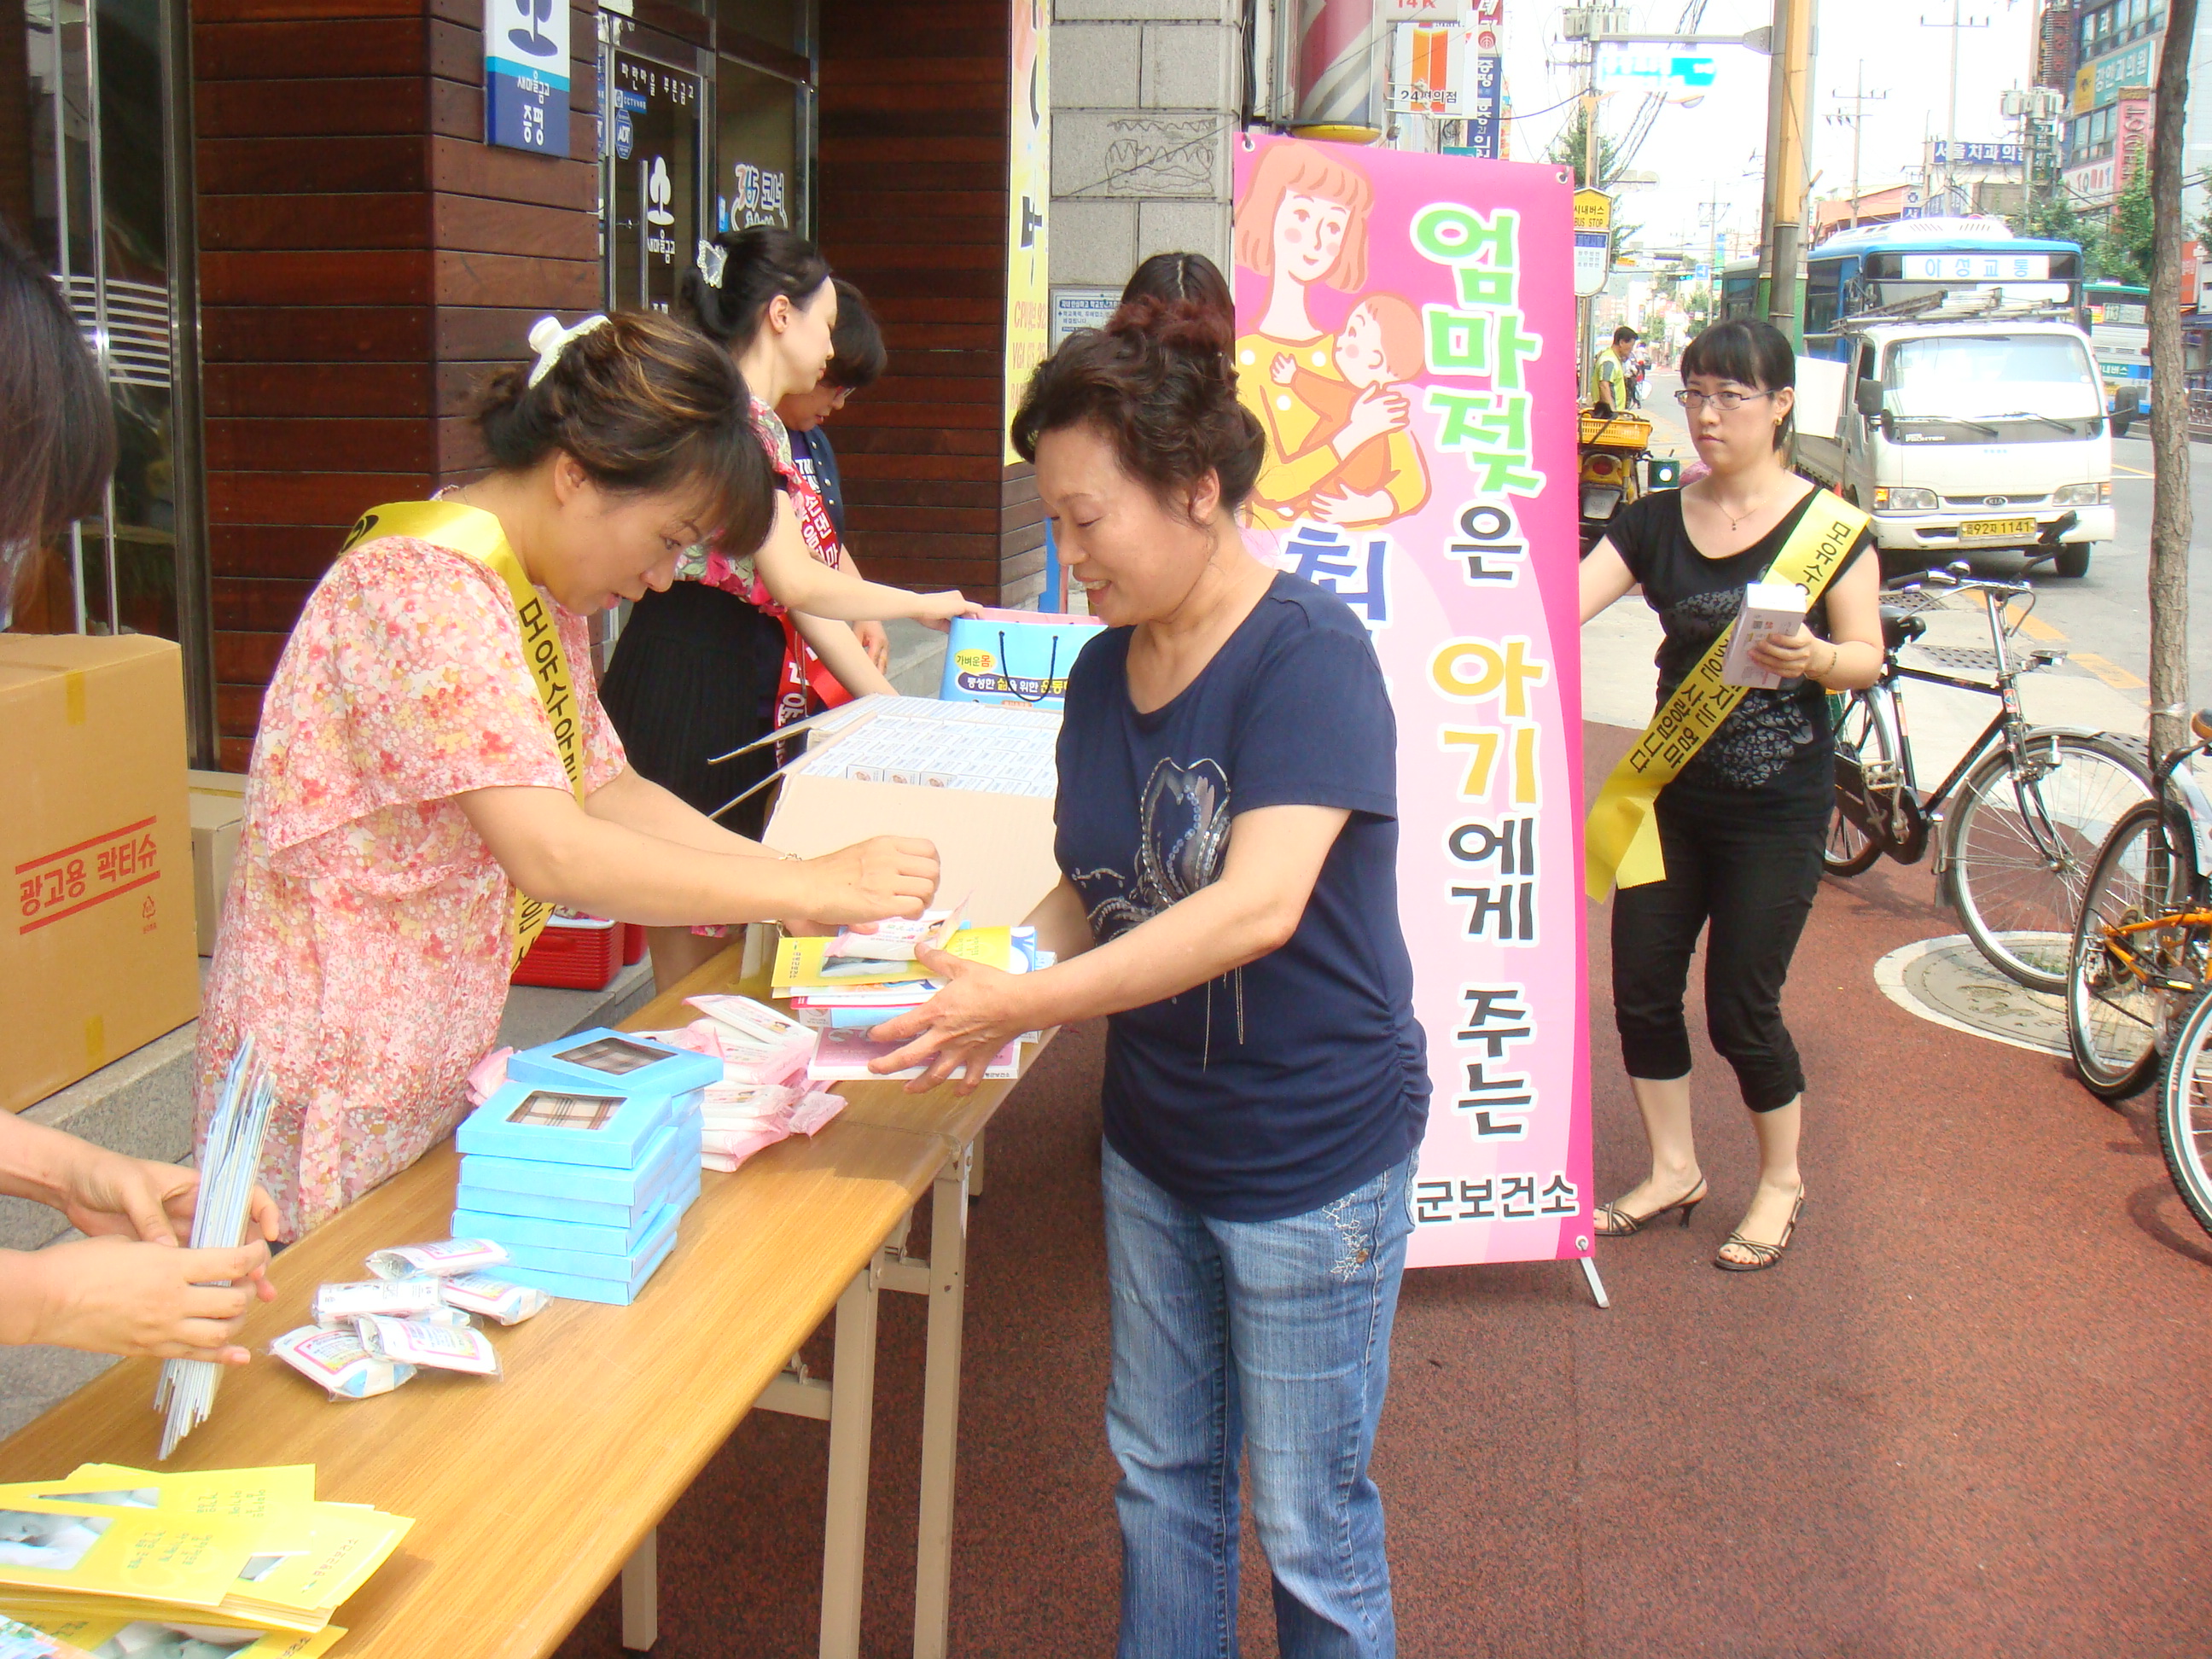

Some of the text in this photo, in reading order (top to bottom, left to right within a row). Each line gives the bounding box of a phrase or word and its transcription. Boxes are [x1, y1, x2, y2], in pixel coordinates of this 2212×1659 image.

[517, 70, 550, 104] 새마을금고
[522, 104, 544, 146] 증평
[618, 125, 631, 143] ADT
[1574, 205, 1605, 215] 시내버스
[1574, 218, 1604, 228] BUS STOP
[2000, 521, 2030, 533] 1141
[1796, 521, 1853, 597] 모유수
[957, 655, 981, 667] 가벼운
[1020, 680, 1039, 694] 위한
[1628, 683, 1702, 774] 사랑입니다
[1663, 726, 1700, 770] 엄마
[1431, 642, 1544, 940] 아기에게
[19, 833, 158, 917] 광고용 곽티슈
[1458, 989, 1532, 1135] 주는
[1416, 1174, 1578, 1223] 군보건소
